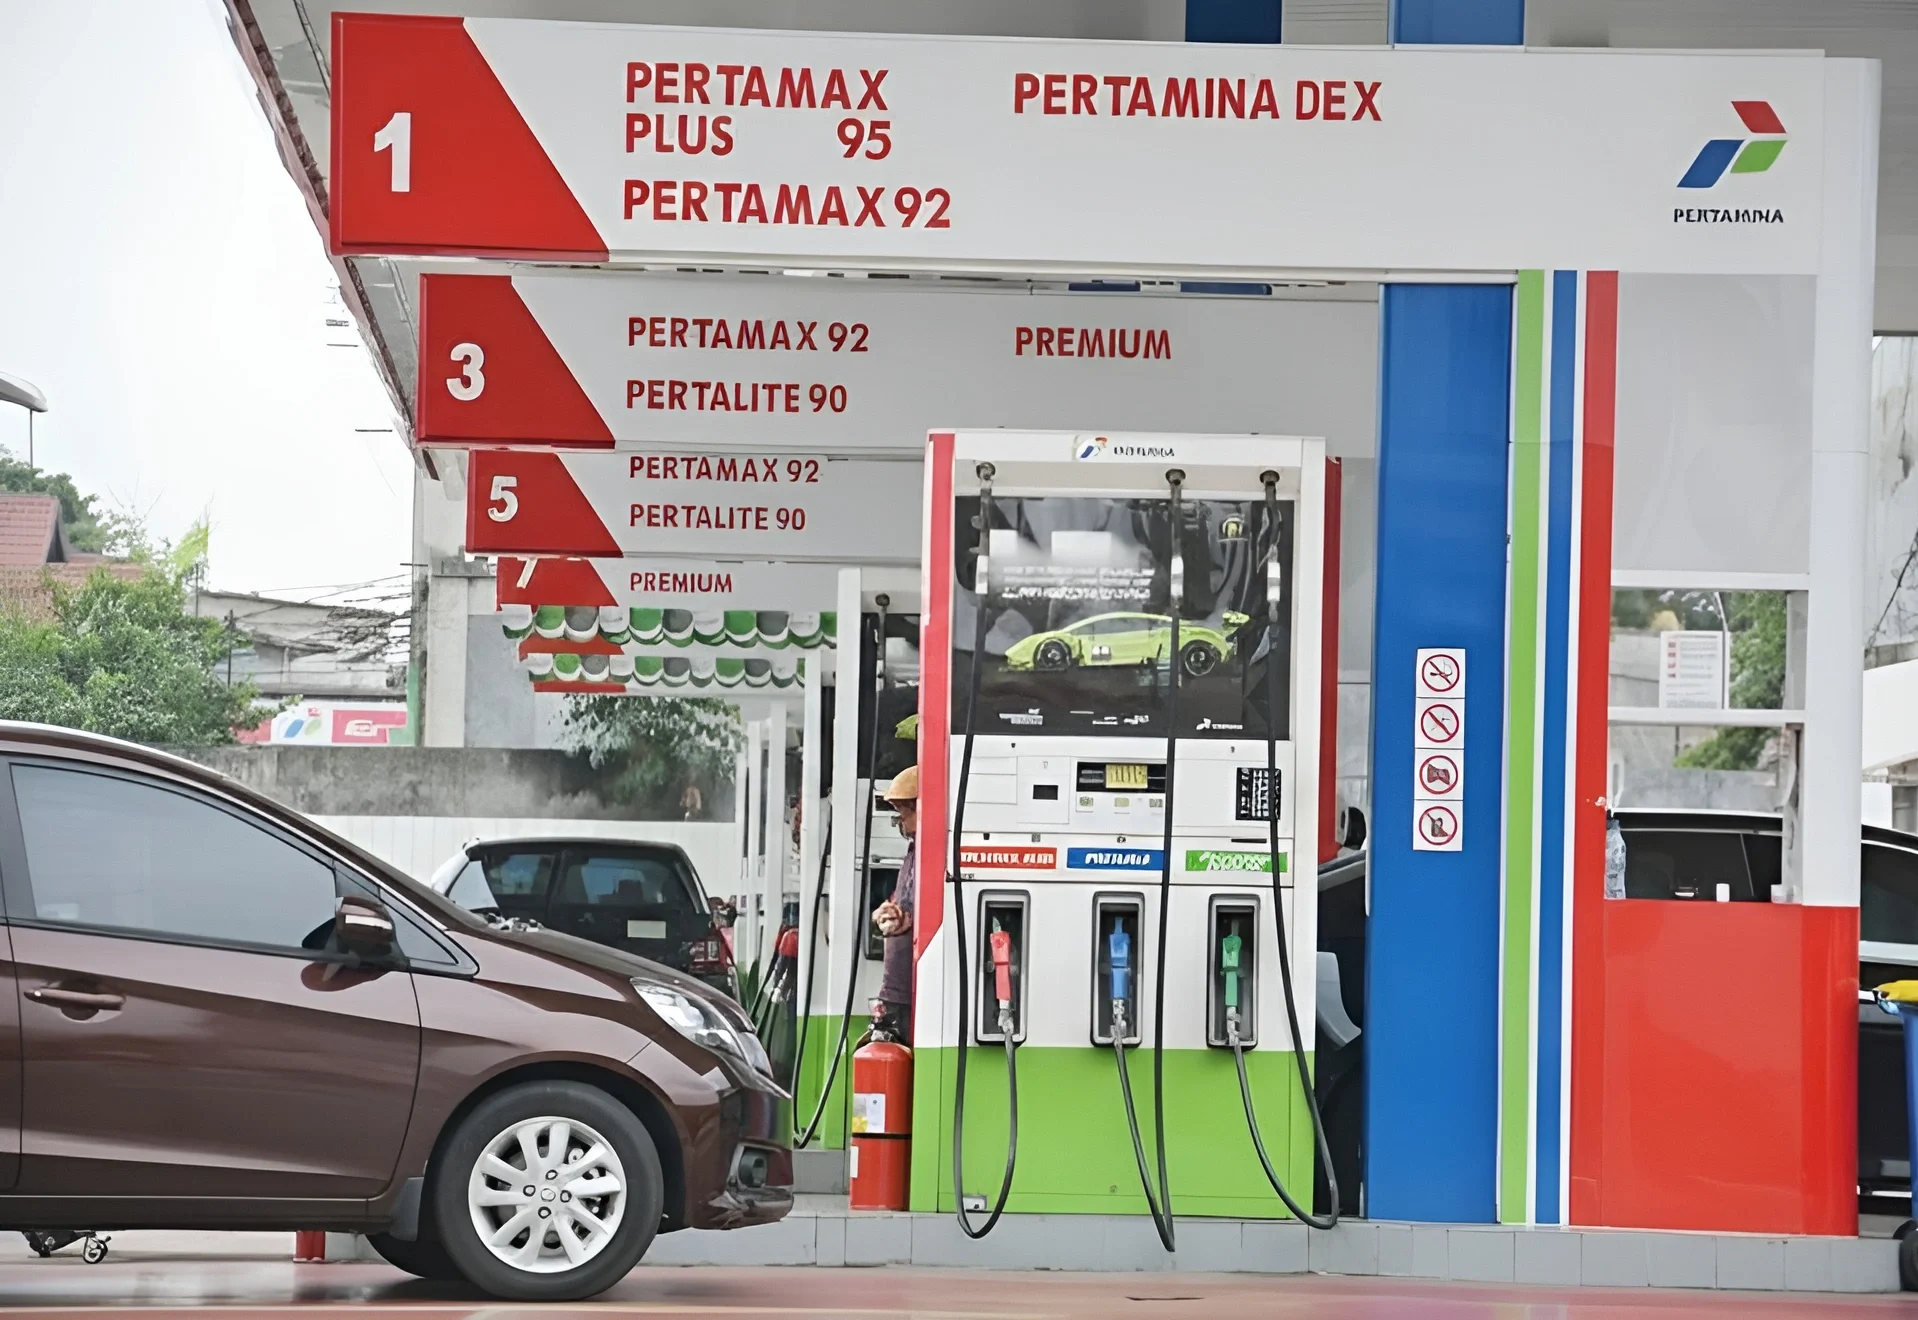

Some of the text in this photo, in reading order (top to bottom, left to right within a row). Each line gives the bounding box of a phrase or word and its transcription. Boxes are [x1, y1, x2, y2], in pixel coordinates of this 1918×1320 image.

[625, 61, 889, 111] PERTAMAX
[1013, 72, 1382, 122] PERTAMINA DEX
[373, 112, 411, 193] 1
[624, 112, 893, 161] PLUS 95
[623, 178, 952, 230] PERTAMAX 92
[627, 315, 870, 353] PERTAMAX 92
[1015, 326, 1172, 360] PREMIUM
[446, 342, 485, 401] 3
[625, 378, 848, 414] PERTALITE 90
[629, 455, 820, 484] PERTAMAX 92
[487, 475, 519, 522] 5
[629, 503, 806, 531] PERTALITE 90
[630, 571, 733, 593] PREMIUM
